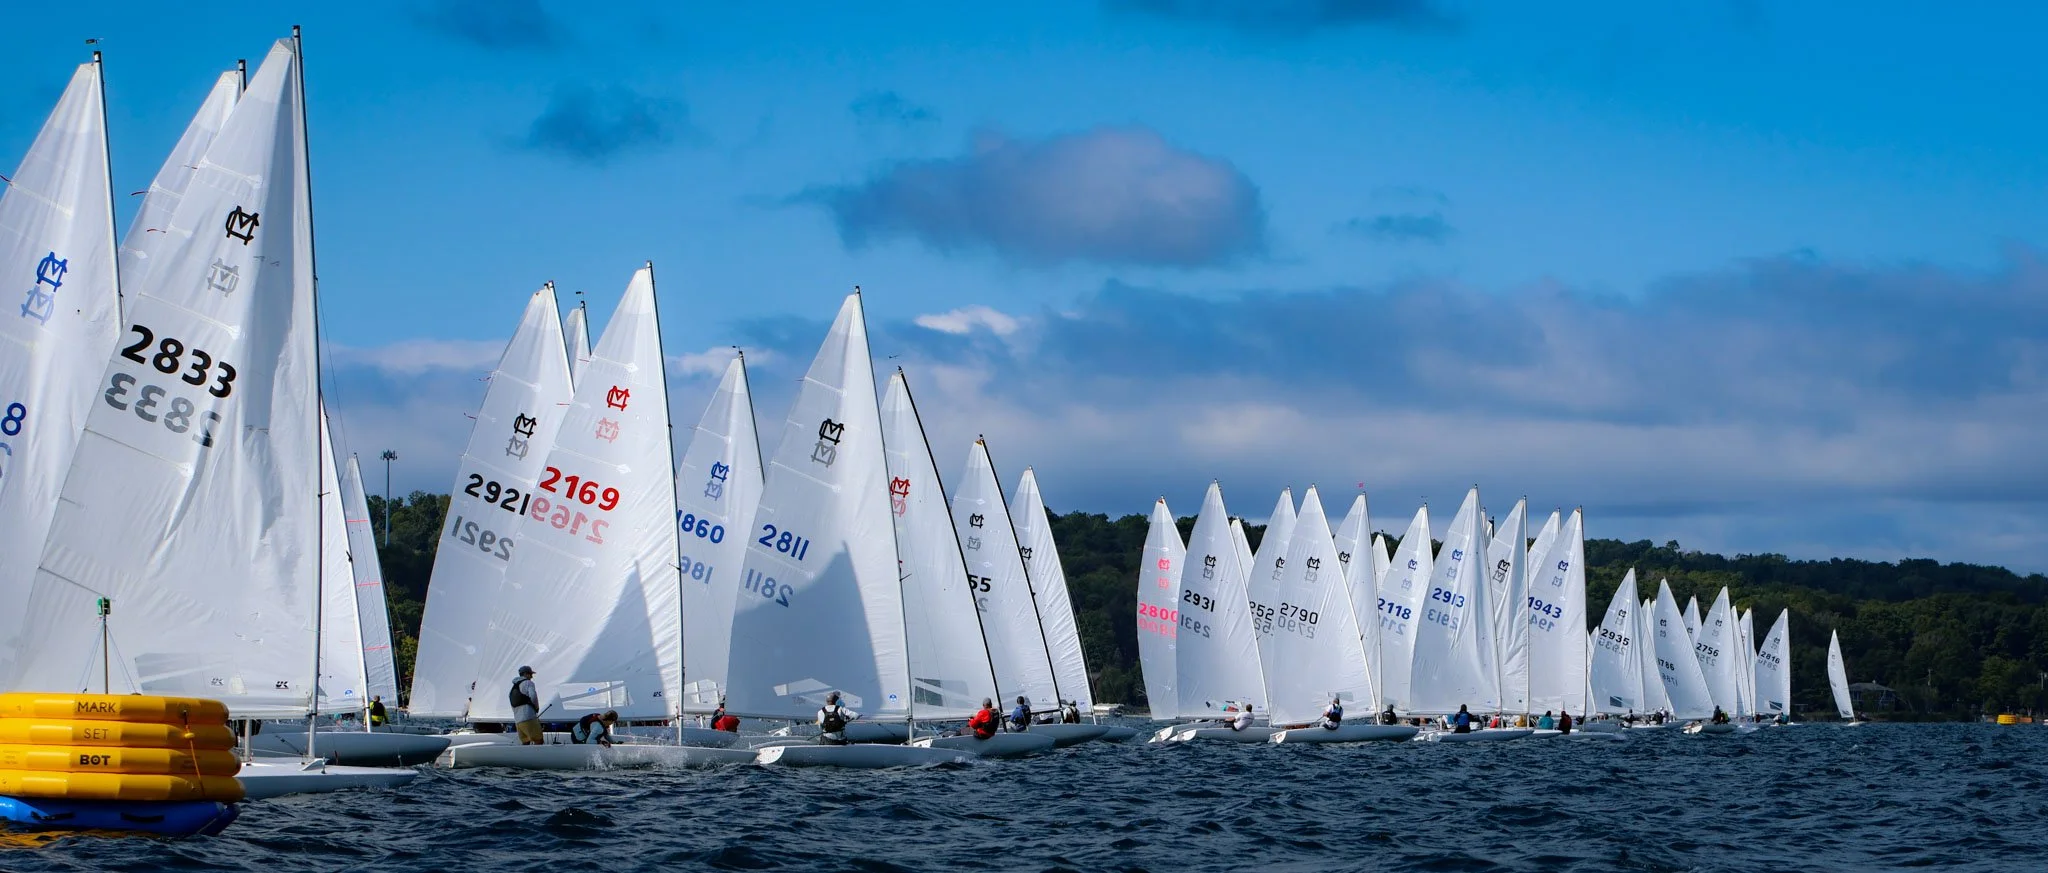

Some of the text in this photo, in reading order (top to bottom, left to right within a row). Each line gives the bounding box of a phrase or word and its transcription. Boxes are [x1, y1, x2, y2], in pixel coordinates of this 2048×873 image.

[121, 324, 237, 398] 2833
[464, 473, 531, 516] 2921
[539, 466, 620, 511] 2169
[758, 524, 810, 561] 2811
[1184, 590, 1215, 612] 2931
[1432, 587, 1465, 608] 2913
[1528, 596, 1562, 619] 1943
[1139, 603, 1178, 623] 2800
[1280, 602, 1319, 625] 2790
[1378, 598, 1412, 620] 2118
[1601, 629, 1630, 646] 2935
[1696, 642, 1719, 657] 2756
[78, 702, 116, 713] MARK
[84, 728, 109, 740] SET
[80, 755, 110, 765] BOT
